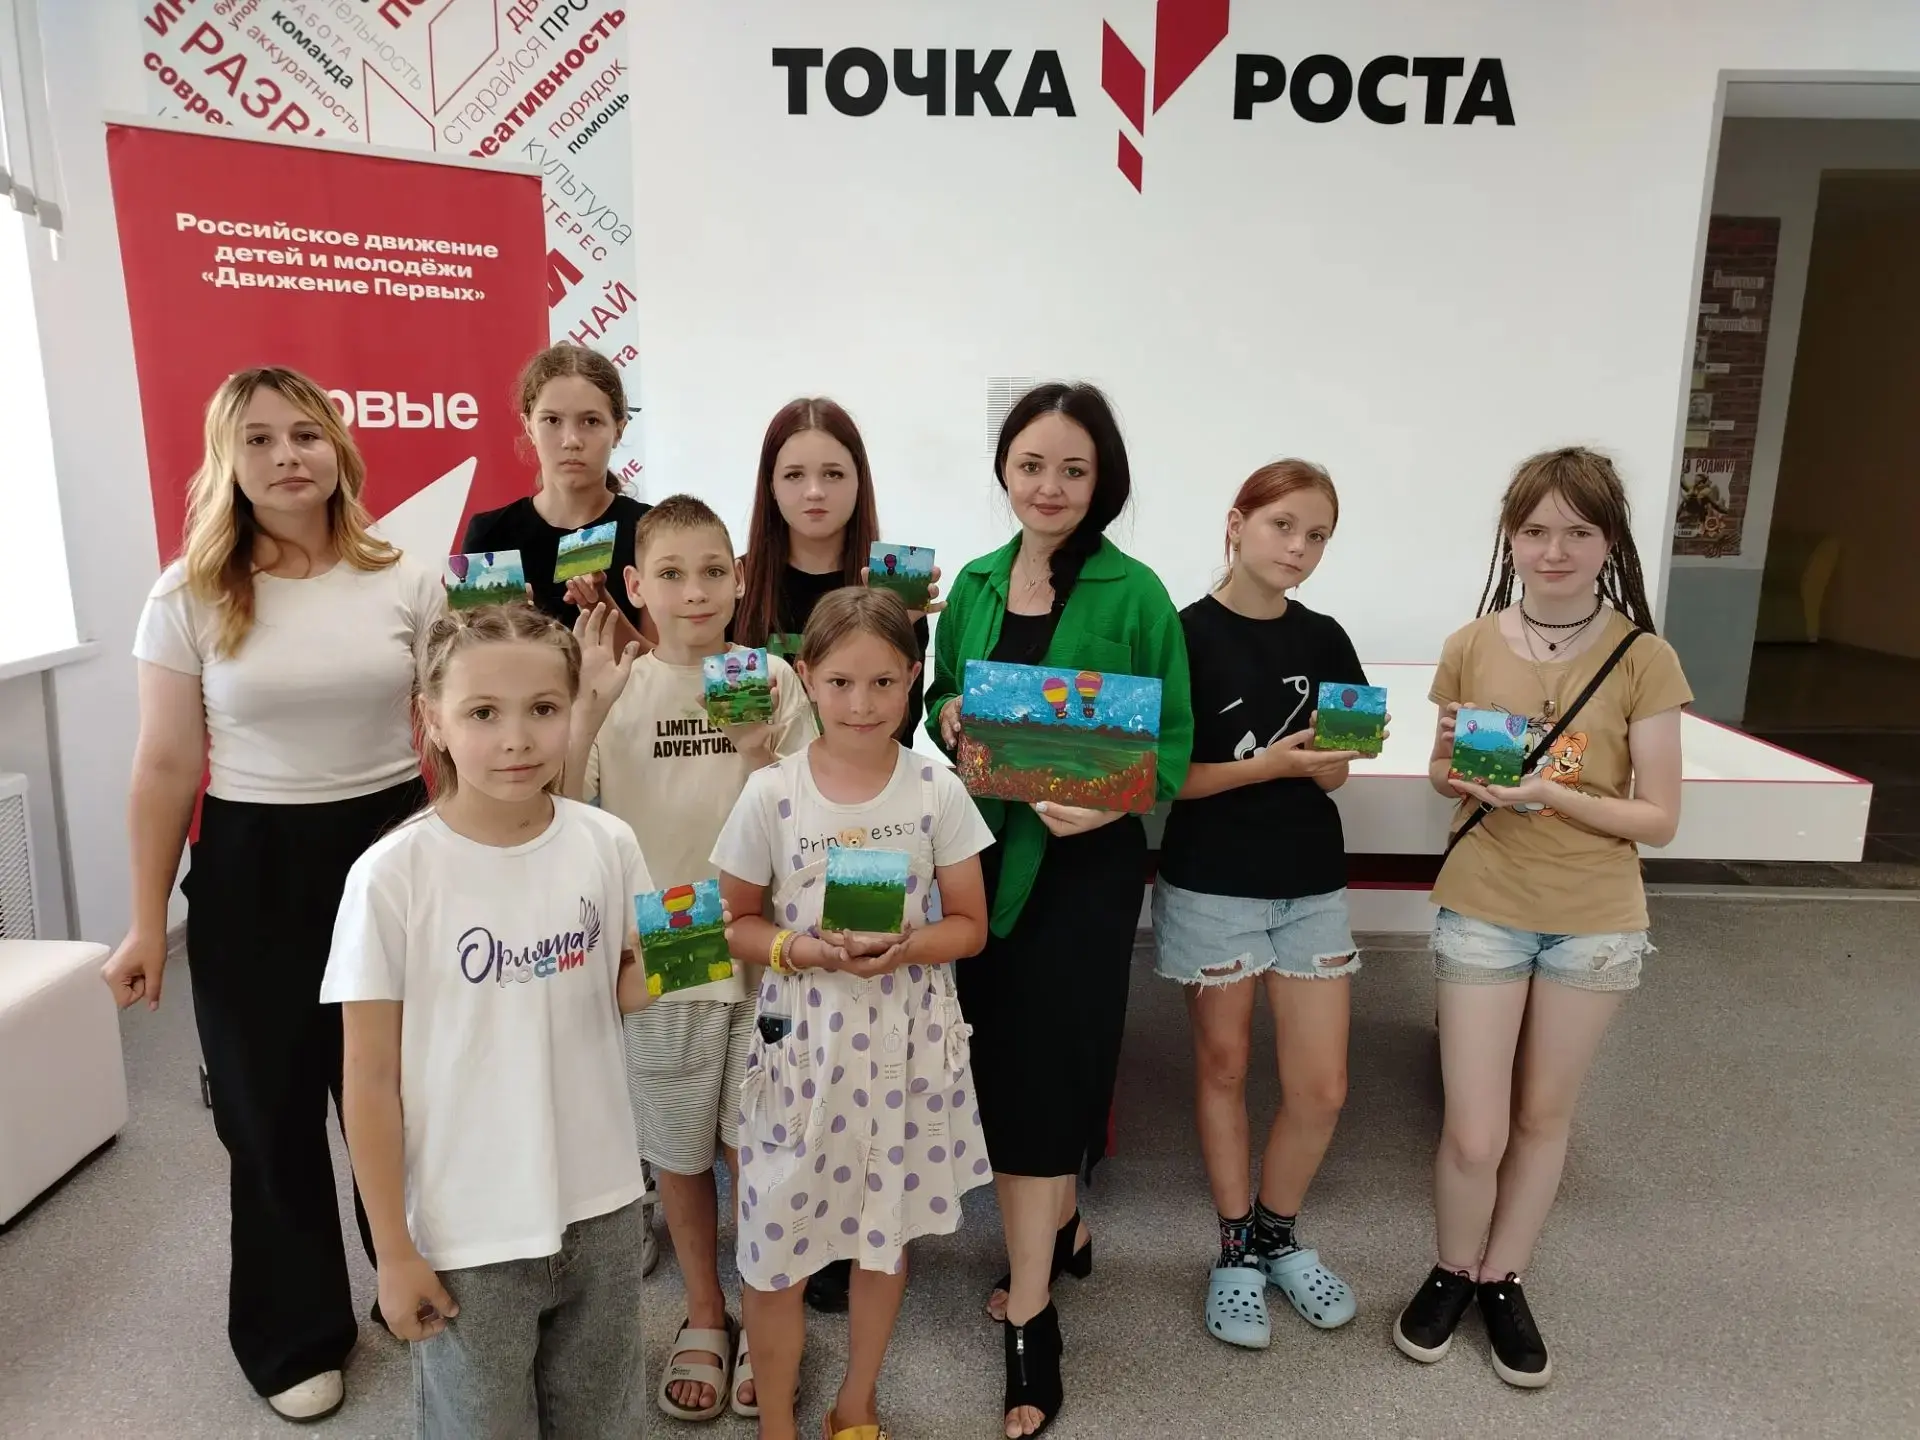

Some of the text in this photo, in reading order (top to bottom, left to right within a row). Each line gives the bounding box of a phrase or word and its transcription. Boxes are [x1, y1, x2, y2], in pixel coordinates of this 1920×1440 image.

[228, 0, 262, 31] упор
[288, 0, 352, 60] АБОТА
[247, 25, 359, 134] аккуратность
[271, 10, 354, 89] команда
[144, 52, 234, 126] совре
[442, 36, 548, 145] старайся
[548, 58, 628, 139] порядок
[772, 47, 1516, 127] ТОЧКА РОСТА
[568, 92, 630, 154] помощь
[521, 137, 632, 246] культура
[175, 212, 499, 259] Российское движение
[542, 192, 607, 261] ТЕРЕС
[201, 266, 486, 301] «Движение Первых»
[214, 245, 473, 279] детей и молодёжи
[656, 719, 724, 737] LIMITLE
[457, 926, 585, 984] Орлята
